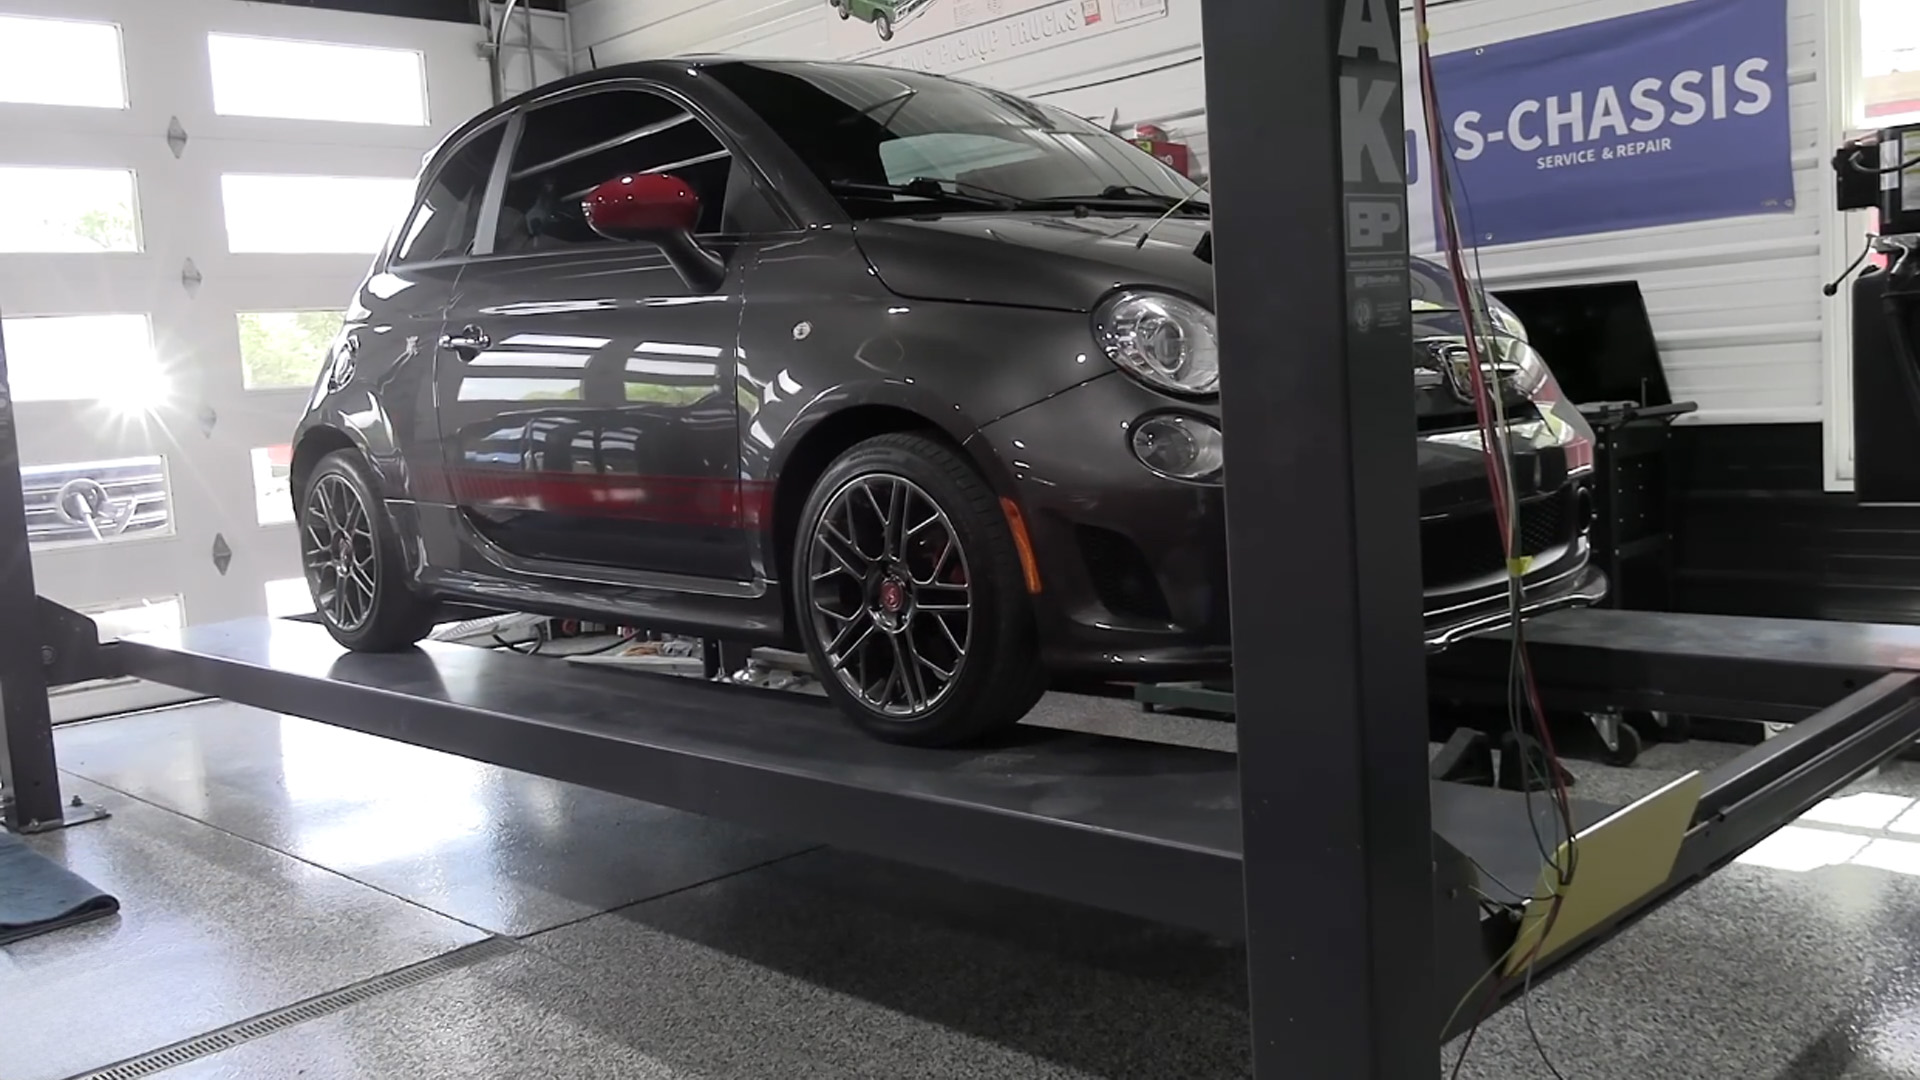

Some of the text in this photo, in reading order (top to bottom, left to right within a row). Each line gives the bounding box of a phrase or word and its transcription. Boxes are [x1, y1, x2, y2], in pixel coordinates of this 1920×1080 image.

[937, 28, 999, 64] PICKUP
[1005, 8, 1078, 46] TRUCKS
[1453, 57, 1772, 160] S-CHASSIS
[1536, 137, 1672, 169] SERVICE & REPAIR
[1349, 202, 1400, 247] BP
